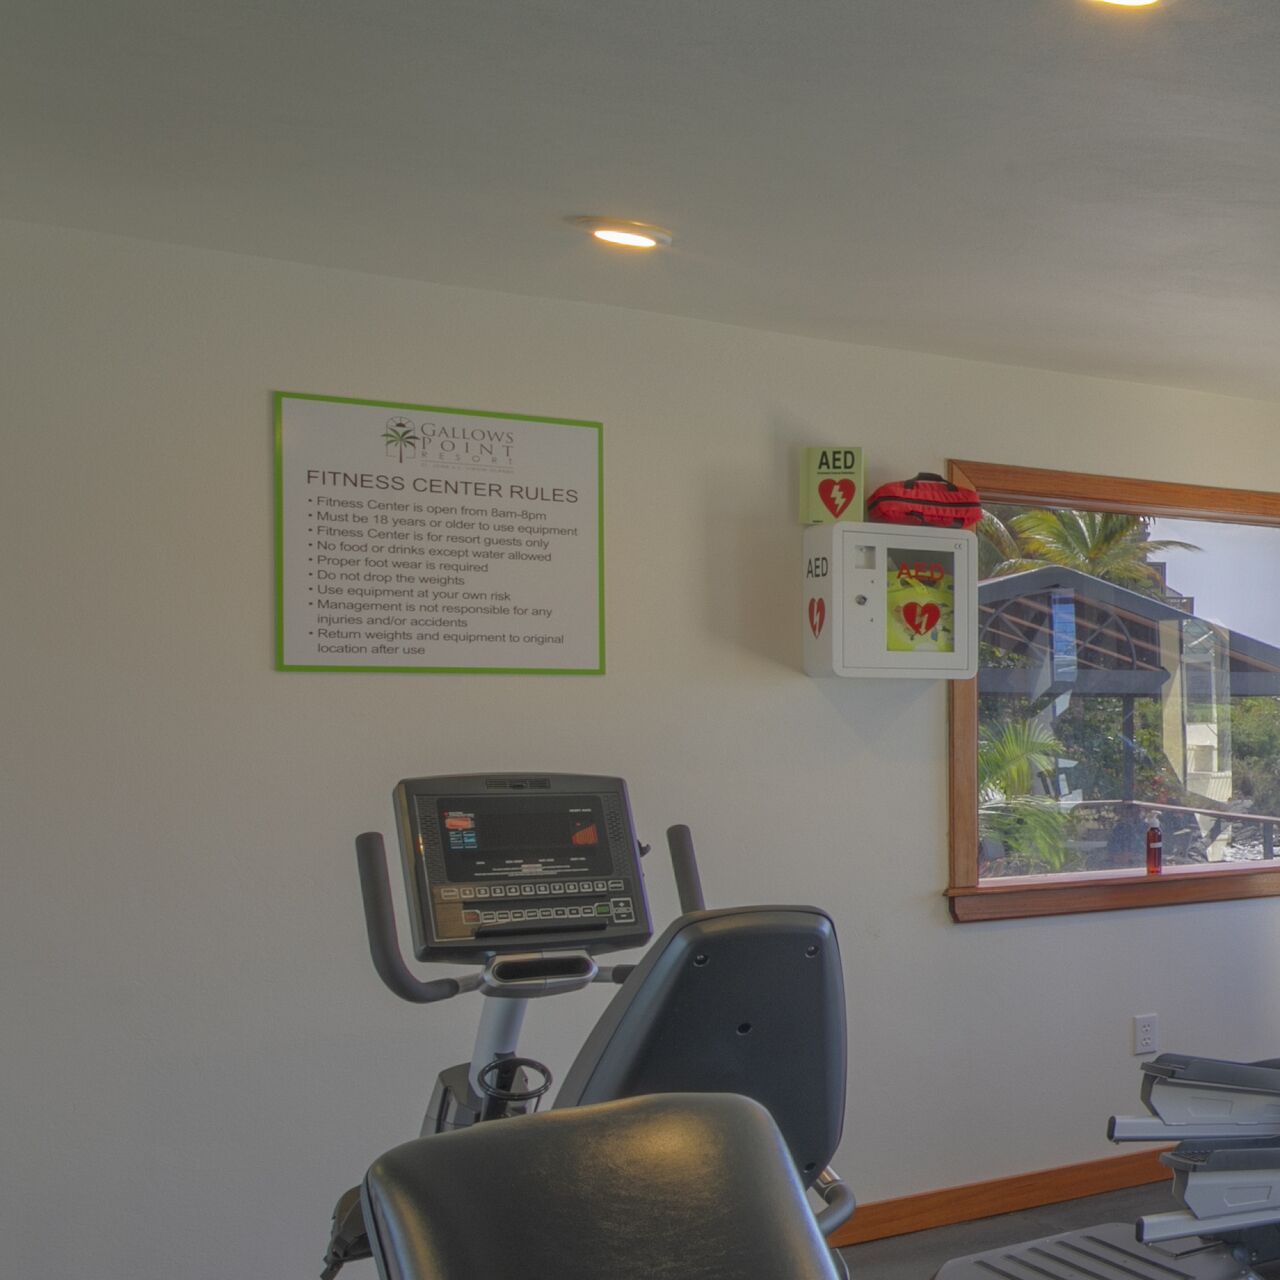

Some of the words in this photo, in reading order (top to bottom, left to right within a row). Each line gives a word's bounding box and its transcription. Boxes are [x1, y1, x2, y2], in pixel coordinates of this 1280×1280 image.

[421, 423, 514, 443] GALLOWS
[421, 437, 514, 457] POINT
[818, 450, 855, 469] AED
[307, 470, 405, 490] FITNESS
[413, 478, 502, 498] CENTER
[510, 485, 578, 503] RULES
[317, 496, 364, 509] Fitness
[367, 499, 410, 512] Center
[413, 503, 423, 512] is
[426, 505, 457, 516] open
[461, 506, 488, 517] from
[491, 508, 547, 521] 8am-8pm
[317, 511, 349, 522] Must
[352, 513, 368, 523] be
[374, 515, 388, 524] 18
[392, 518, 426, 527] years
[429, 519, 442, 528] or
[445, 520, 475, 530] older
[479, 521, 490, 531] to
[493, 523, 514, 532] use
[517, 524, 578, 537] equipment
[317, 525, 364, 538] Fitness
[367, 528, 410, 540] Center
[413, 531, 423, 541] is
[427, 531, 443, 542] for
[446, 534, 481, 544] resort
[484, 536, 522, 547] guests
[525, 538, 550, 550] only
[317, 540, 336, 551] No
[340, 541, 368, 552] food
[371, 545, 384, 553] or
[388, 544, 425, 556] drinks
[428, 548, 469, 559] except
[472, 549, 506, 560] water
[508, 551, 552, 561] allowed
[317, 555, 361, 567] Proper
[364, 557, 389, 568] foot
[392, 560, 422, 569] wear
[426, 560, 436, 570] is
[439, 562, 488, 573] required
[806, 557, 829, 579] AED
[897, 562, 945, 582] AED
[317, 570, 336, 580] Do
[340, 572, 361, 581] not
[364, 572, 392, 583] drop
[396, 573, 415, 583] the
[420, 575, 465, 587] weights
[317, 584, 343, 595] Use
[347, 586, 414, 598] equipment
[417, 588, 429, 598] at
[432, 590, 460, 600] your
[462, 592, 487, 600] own
[490, 592, 511, 601] risk
[317, 599, 402, 612] Management
[405, 602, 416, 612] is
[419, 603, 439, 612] not
[442, 604, 510, 615] responsible
[513, 605, 528, 616] for
[531, 608, 552, 618] any
[317, 614, 363, 626] injuries
[366, 616, 407, 626] and/or
[410, 617, 468, 628] accidents
[365, 630, 413, 642] weights
[416, 631, 440, 641] and
[443, 632, 506, 643] equipment
[509, 633, 520, 643] to
[523, 634, 564, 645] original
[317, 643, 367, 654] location
[371, 644, 400, 655] after
[402, 646, 426, 655] use
